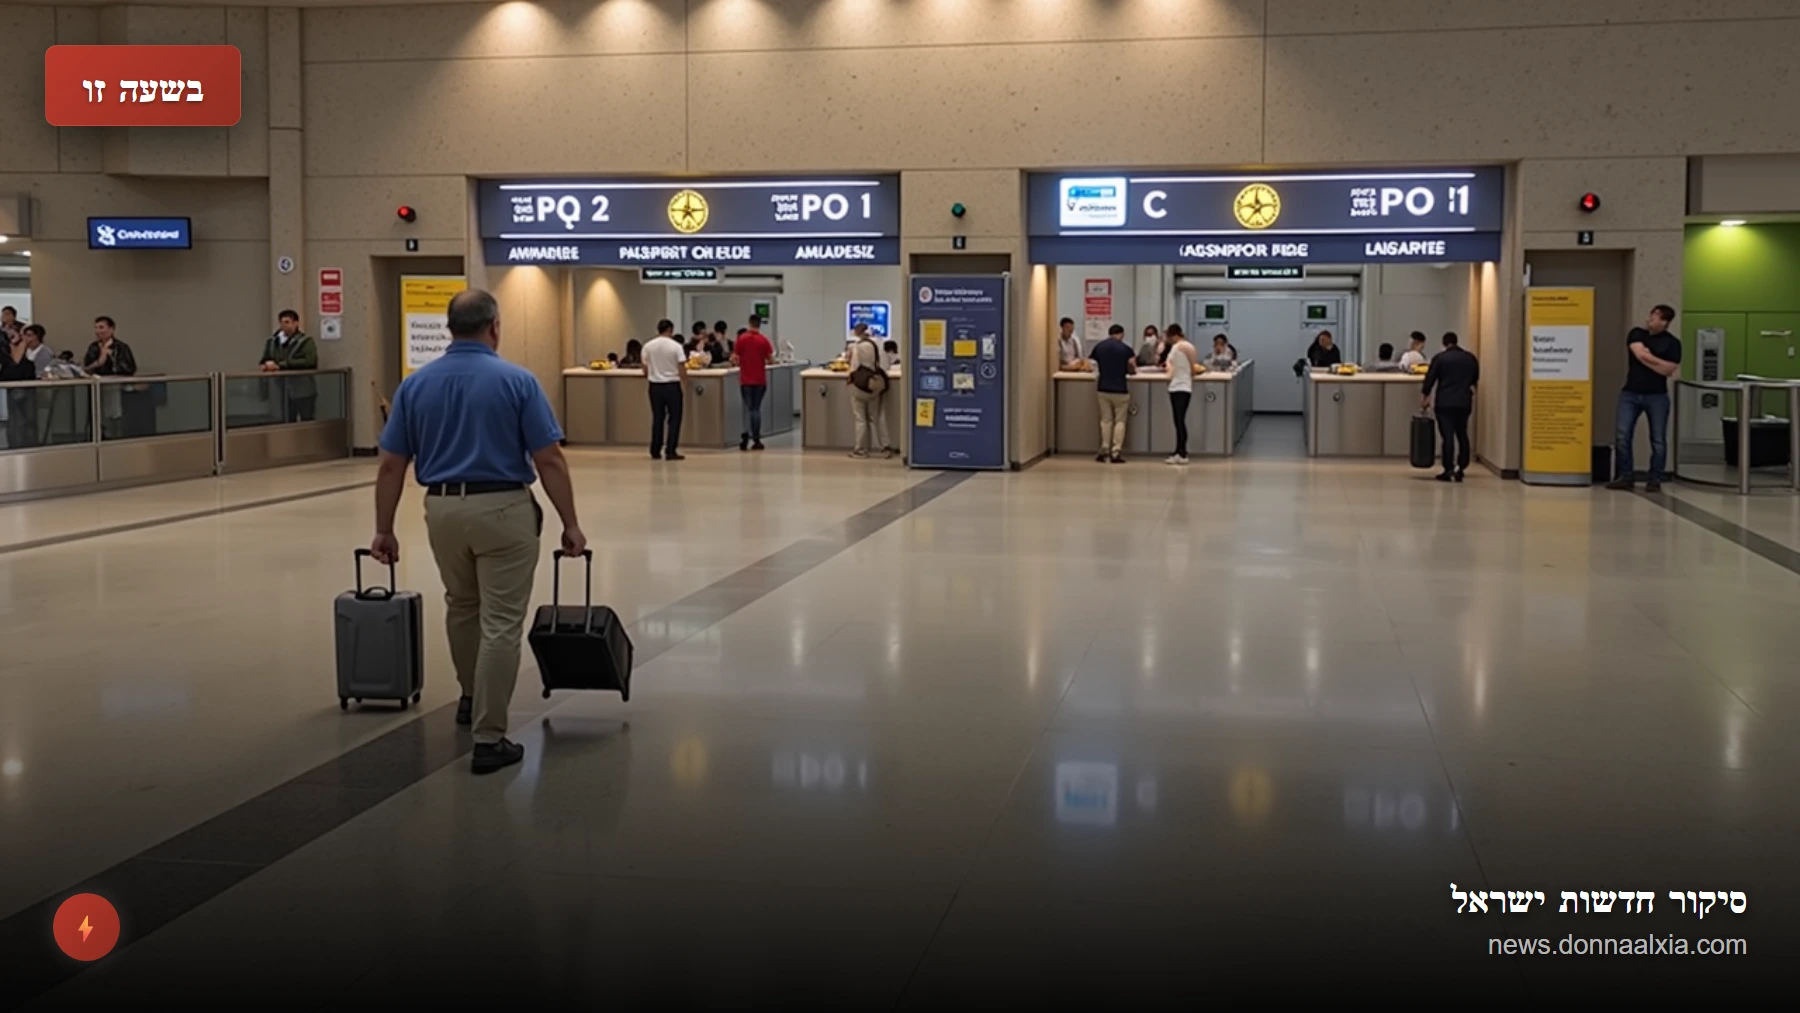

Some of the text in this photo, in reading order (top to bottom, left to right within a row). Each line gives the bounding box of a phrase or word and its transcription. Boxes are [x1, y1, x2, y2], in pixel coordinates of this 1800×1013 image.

[536, 194, 582, 230] PQ
[591, 194, 610, 222] 2
[802, 193, 850, 221] PO
[860, 192, 871, 219] 1
[1142, 190, 1169, 219] C
[1380, 186, 1436, 217] PO
